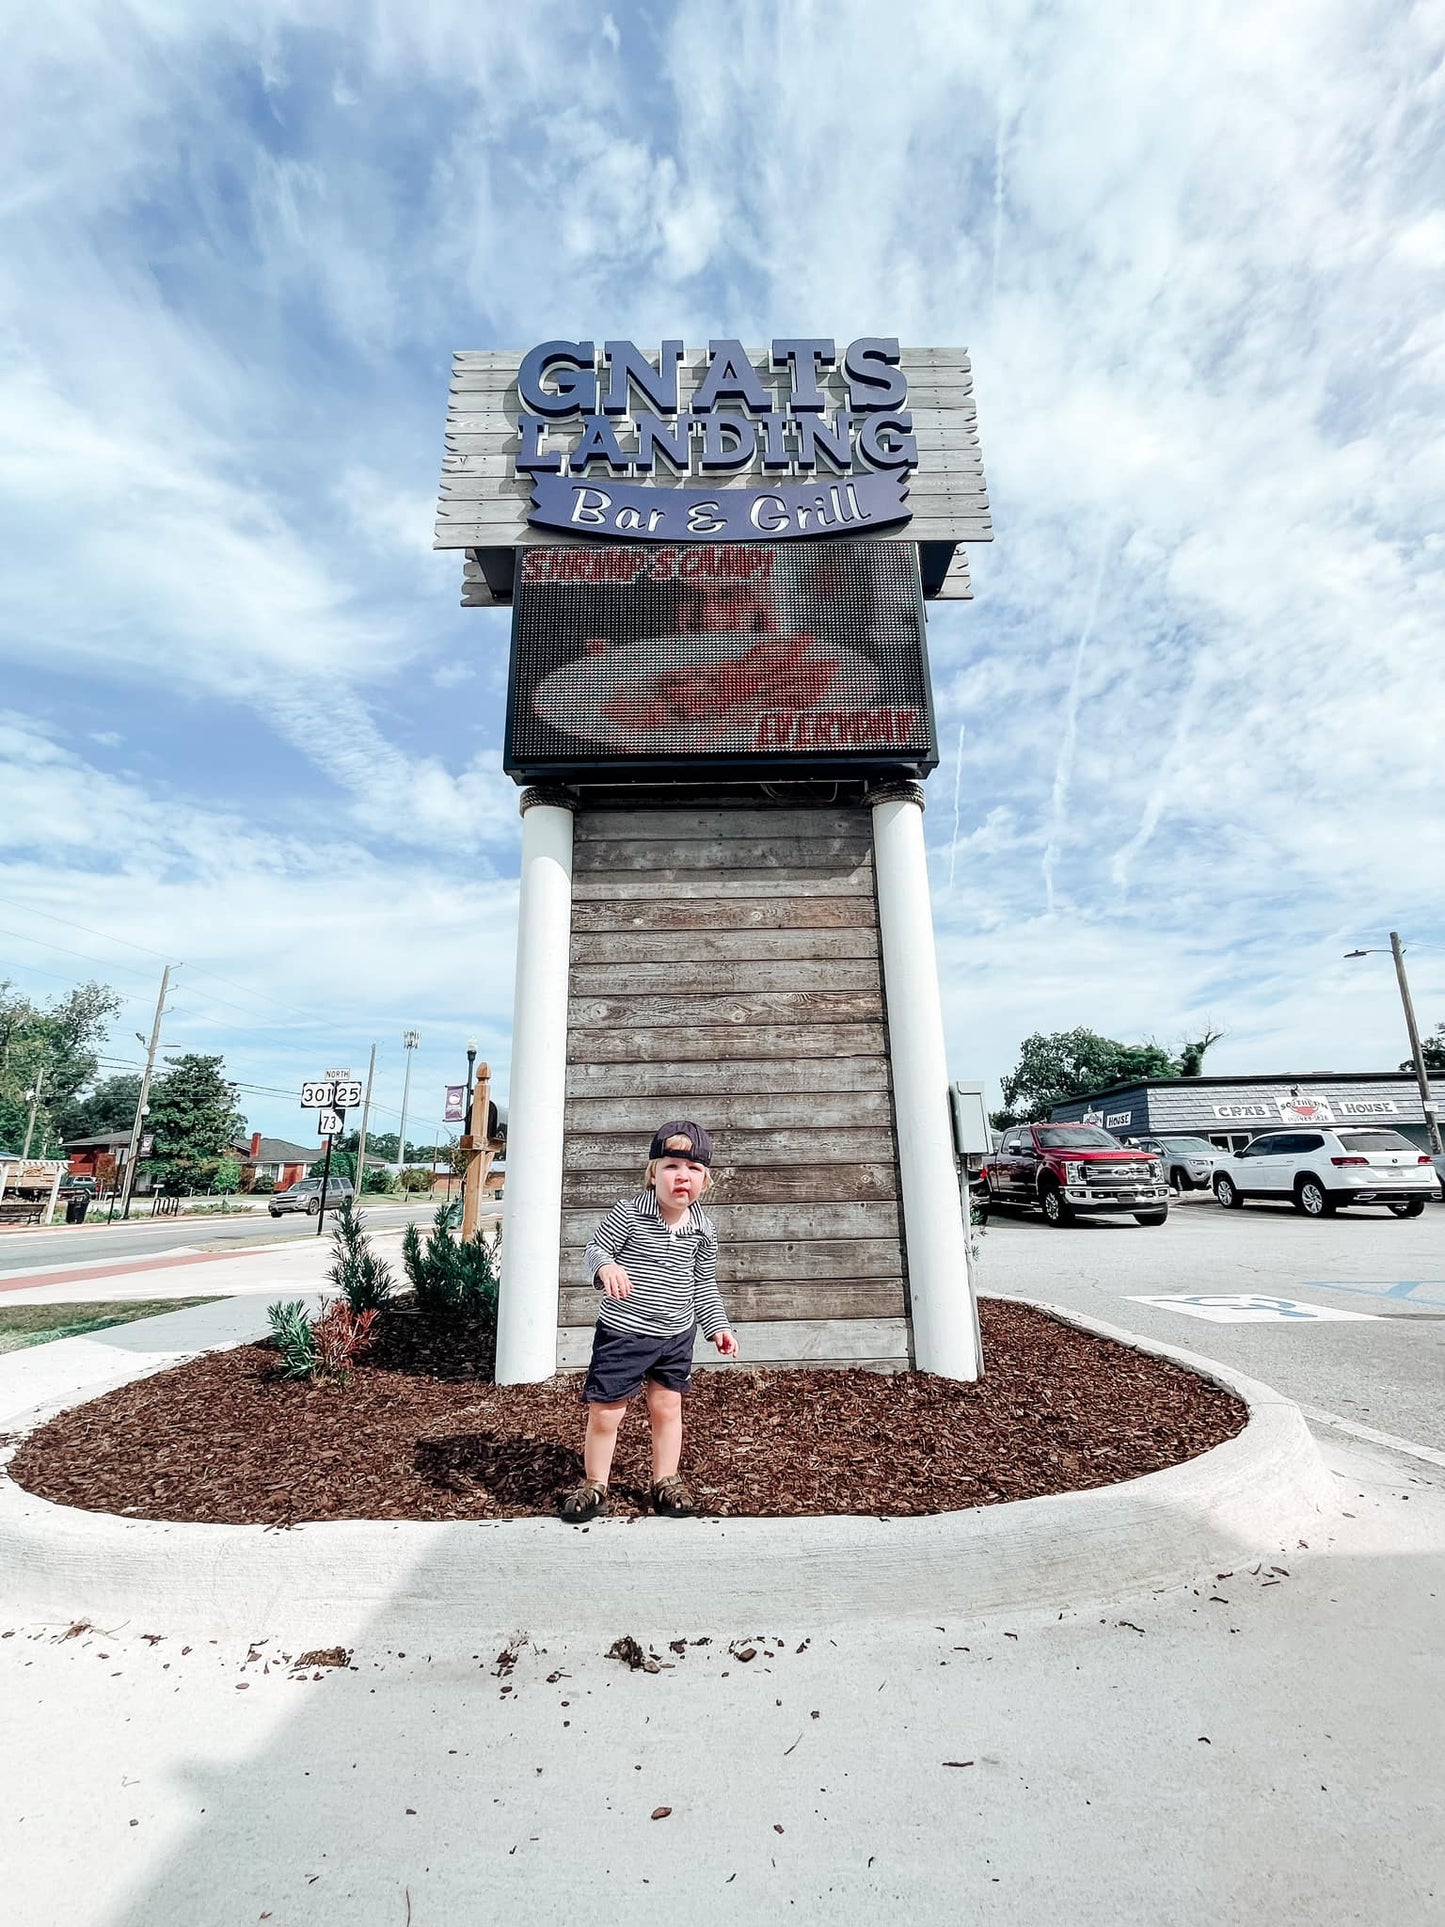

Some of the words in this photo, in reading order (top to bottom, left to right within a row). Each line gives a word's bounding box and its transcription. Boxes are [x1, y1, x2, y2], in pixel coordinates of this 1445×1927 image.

[518, 338, 908, 416] GNATS
[516, 411, 918, 471] LANDING
[570, 486, 665, 532] Bar
[687, 502, 727, 534] &
[750, 484, 871, 532] Grill
[326, 1070, 349, 1078] NORTH
[304, 1088, 331, 1102] 301
[338, 1088, 359, 1101] 25
[1218, 1106, 1266, 1117] CRAB
[1345, 1102, 1393, 1113] HOUSE
[323, 1116, 336, 1130] 73
[1108, 1113, 1129, 1126] HOUSE
